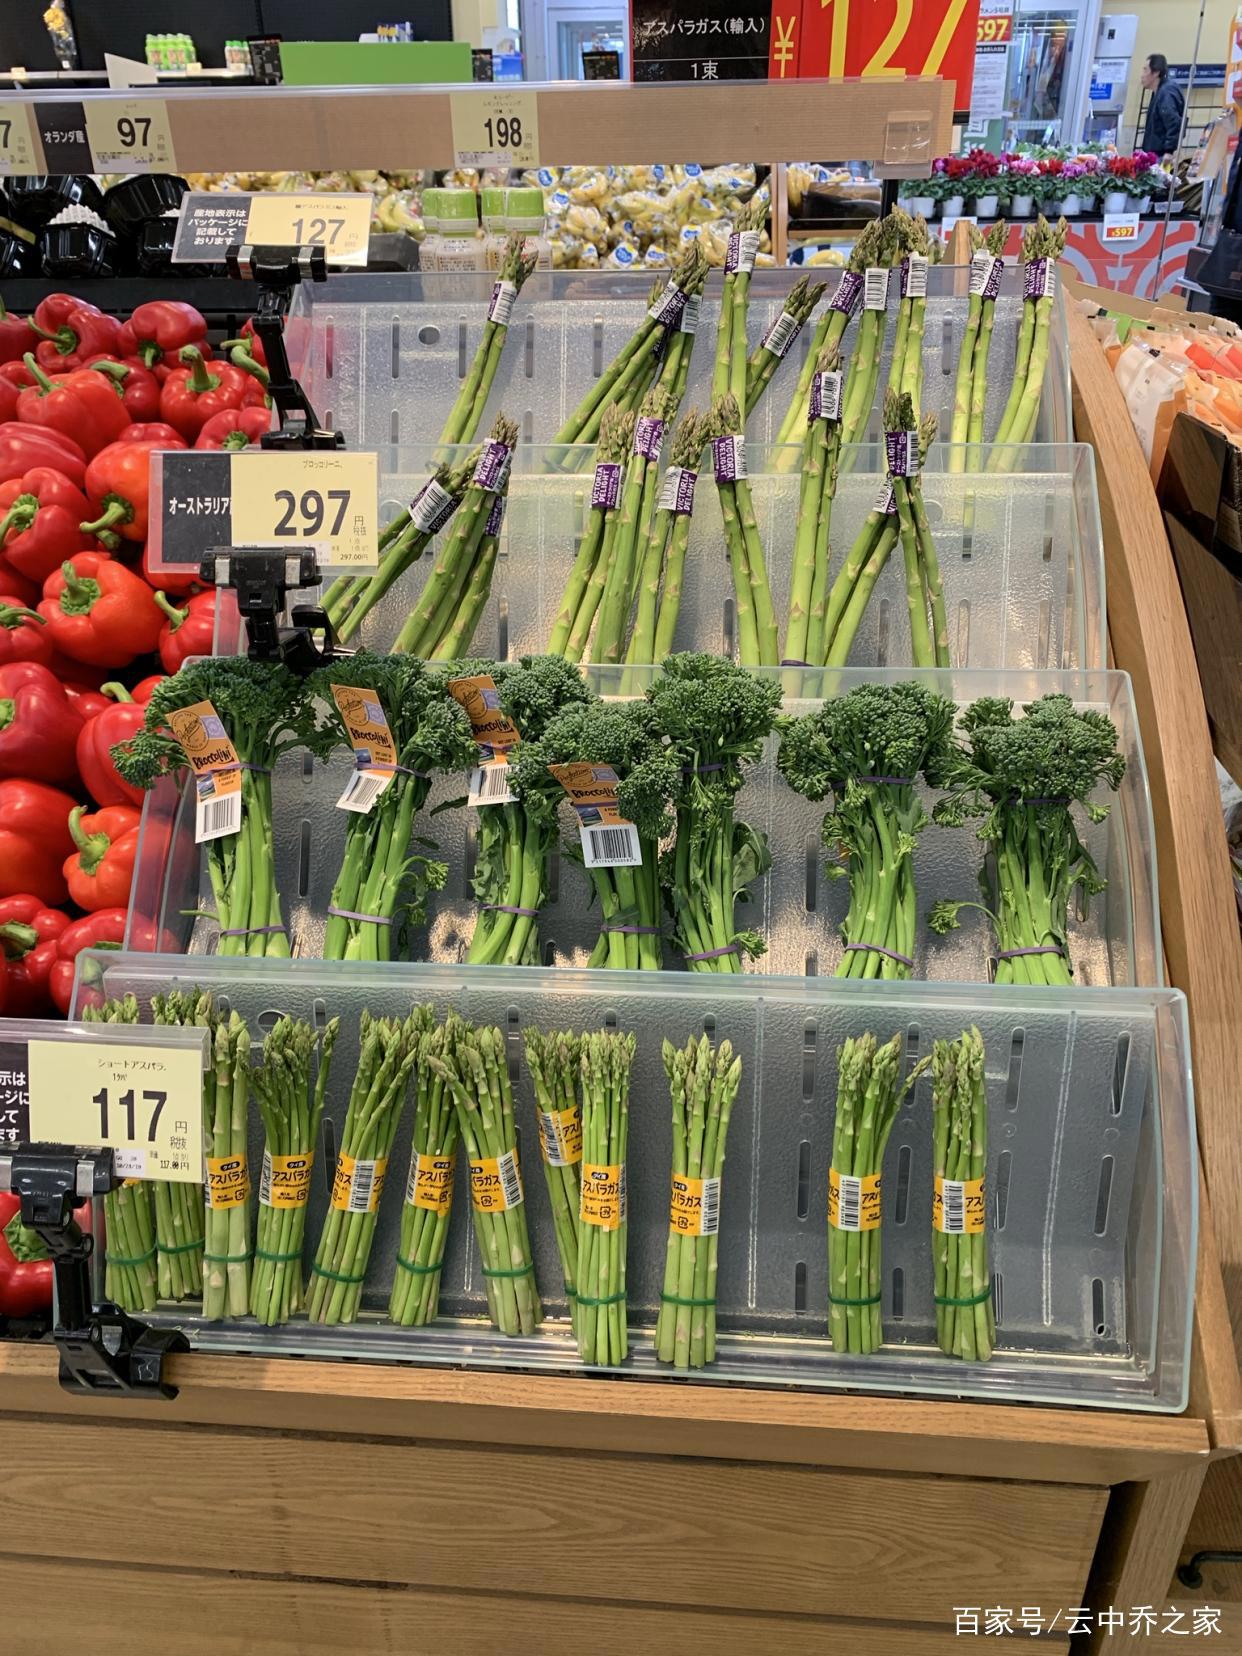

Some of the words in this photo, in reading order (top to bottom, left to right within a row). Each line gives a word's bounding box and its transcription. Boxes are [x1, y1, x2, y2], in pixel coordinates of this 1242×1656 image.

[690, 60, 719, 80] 1束
[117, 117, 151, 147] 97
[484, 117, 522, 148] 198
[188, 218, 248, 227] パッケージに
[193, 208, 246, 218] 産地表示は
[193, 236, 236, 246] おります
[195, 227, 238, 236] 記載して
[291, 218, 346, 245] 127
[984, 261, 1001, 296] VICTORIA
[1028, 265, 1037, 294] DELIGHT
[658, 291, 684, 322] VICTORIA
[665, 297, 686, 324] DELIGHT
[642, 422, 654, 453] DELIGHT
[479, 447, 497, 480] DELIGHT
[719, 442, 727, 477] DELIGHT
[725, 438, 735, 479] VICTORIA
[887, 436, 896, 471] DELIGHT
[592, 466, 604, 504] VICTORIA
[598, 470, 610, 502] DELIGHT
[677, 473, 689, 510] VICTORIA
[684, 477, 695, 511] DELIGHT
[169, 496, 232, 515] オーストラリア
[274, 490, 350, 536] 297
[355, 515, 364, 526] 円
[430, 500, 457, 530] VICTORIA
[93, 1087, 167, 1142] 117
[175, 1121, 188, 1134] 円
